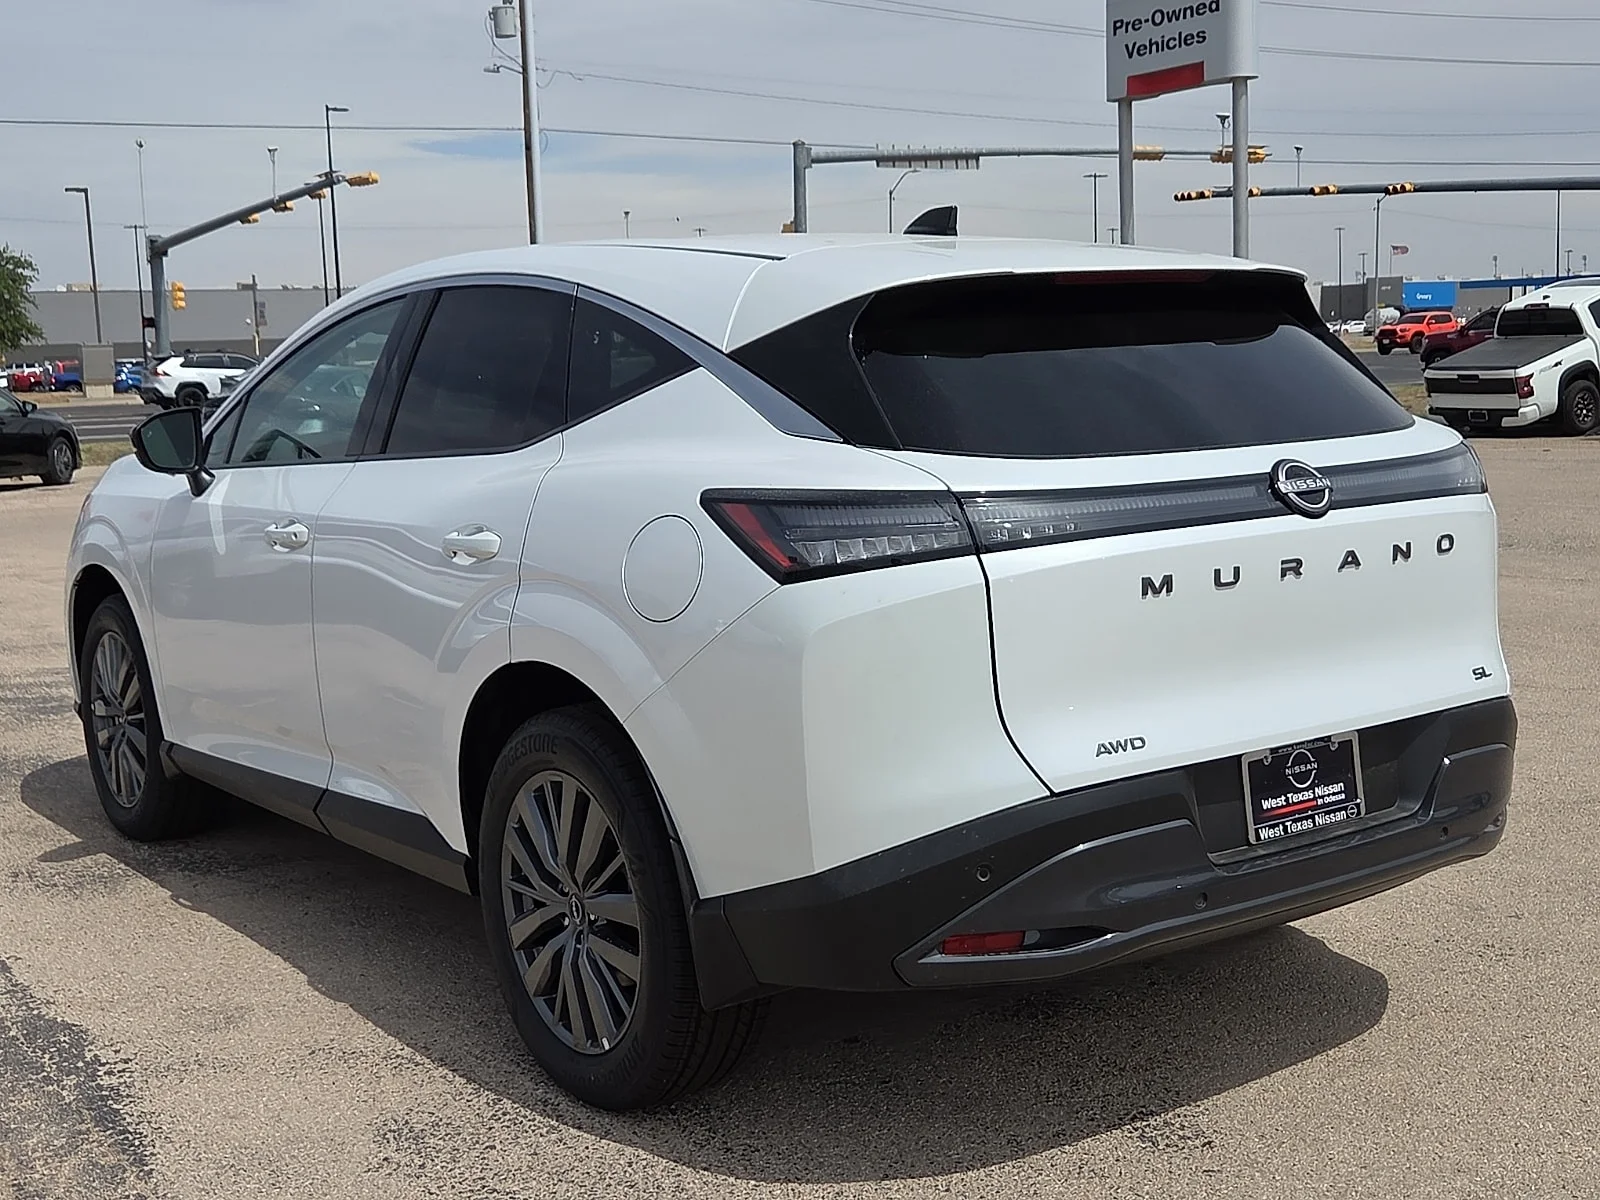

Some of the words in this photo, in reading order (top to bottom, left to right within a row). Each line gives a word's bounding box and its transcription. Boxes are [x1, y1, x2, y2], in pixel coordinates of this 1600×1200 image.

[1112, 0, 1220, 36] Pre-Owned
[1124, 30, 1207, 59] Vehicles
[1277, 477, 1331, 492] NISSAN
[1141, 534, 1455, 599] MURANO
[1471, 666, 1493, 681] SL
[1095, 736, 1146, 757] AWD
[1285, 761, 1318, 776] NISSAN
[1261, 795, 1286, 810] West
[1287, 790, 1314, 804] Texas
[1314, 782, 1345, 797] Nissan
[1323, 793, 1346, 803] Odessa
[1259, 825, 1284, 840] West
[1285, 820, 1313, 833] Texas
[1314, 810, 1347, 827] Nissan
